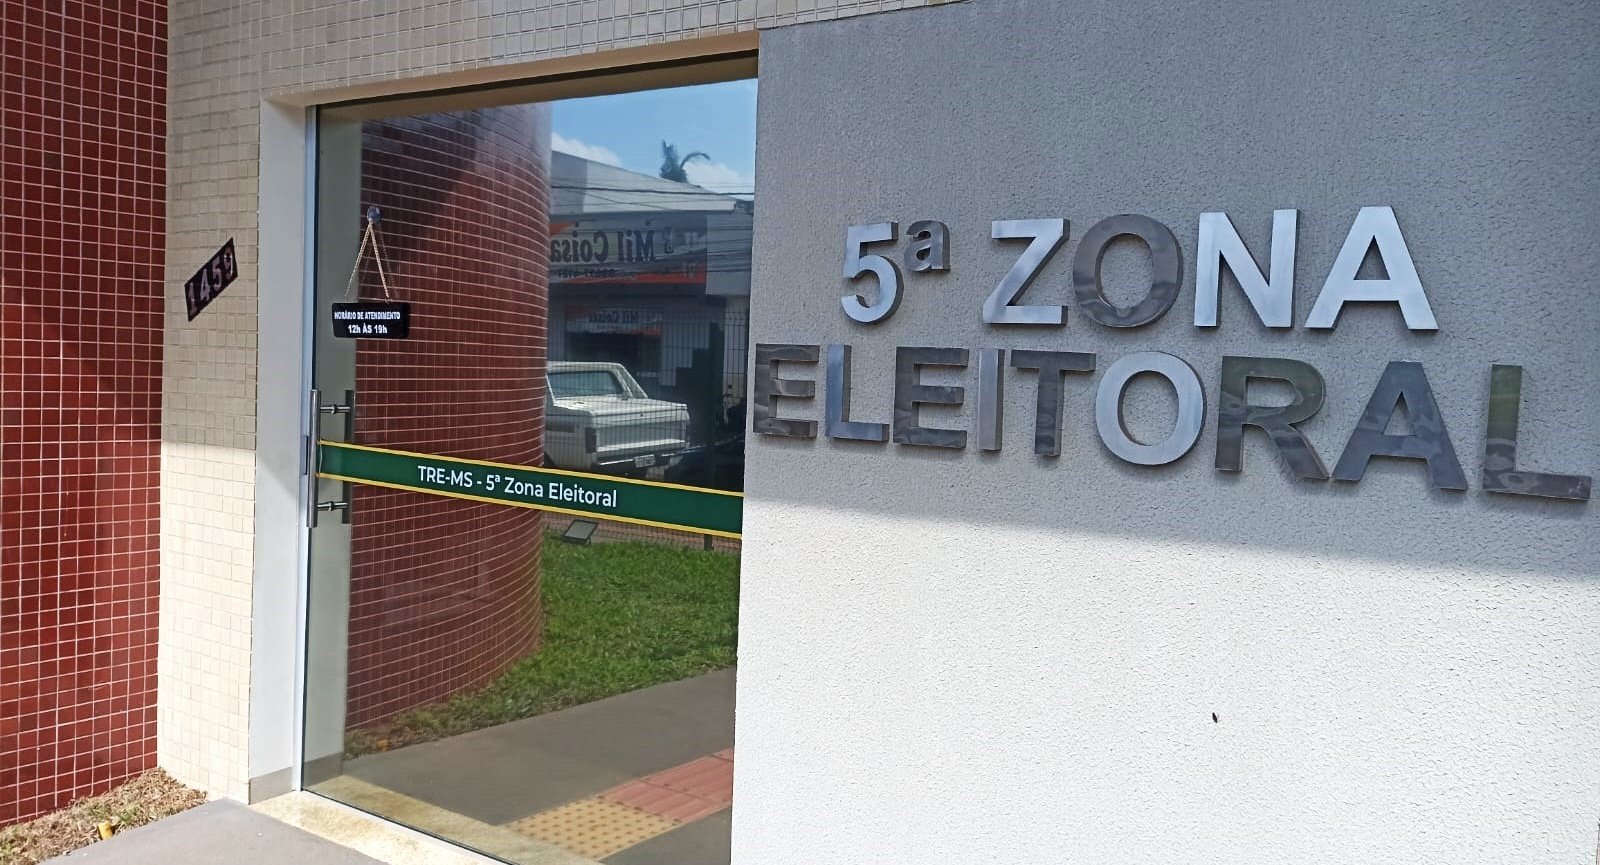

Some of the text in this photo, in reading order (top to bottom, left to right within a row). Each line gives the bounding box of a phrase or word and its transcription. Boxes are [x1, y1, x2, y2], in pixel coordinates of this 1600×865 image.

[187, 246, 233, 316] 1459
[841, 205, 1439, 330] 5ª ZONA
[334, 310, 401, 320] HORÁRIO DE ATENDIMENTO
[348, 322, 388, 334] 12h ÀS 19h
[752, 343, 1592, 500] ELEITORAL
[417, 465, 473, 488] TRE-MS
[486, 474, 501, 491] 5ª
[504, 477, 544, 498] Zona
[548, 483, 617, 508] Eleitoral
